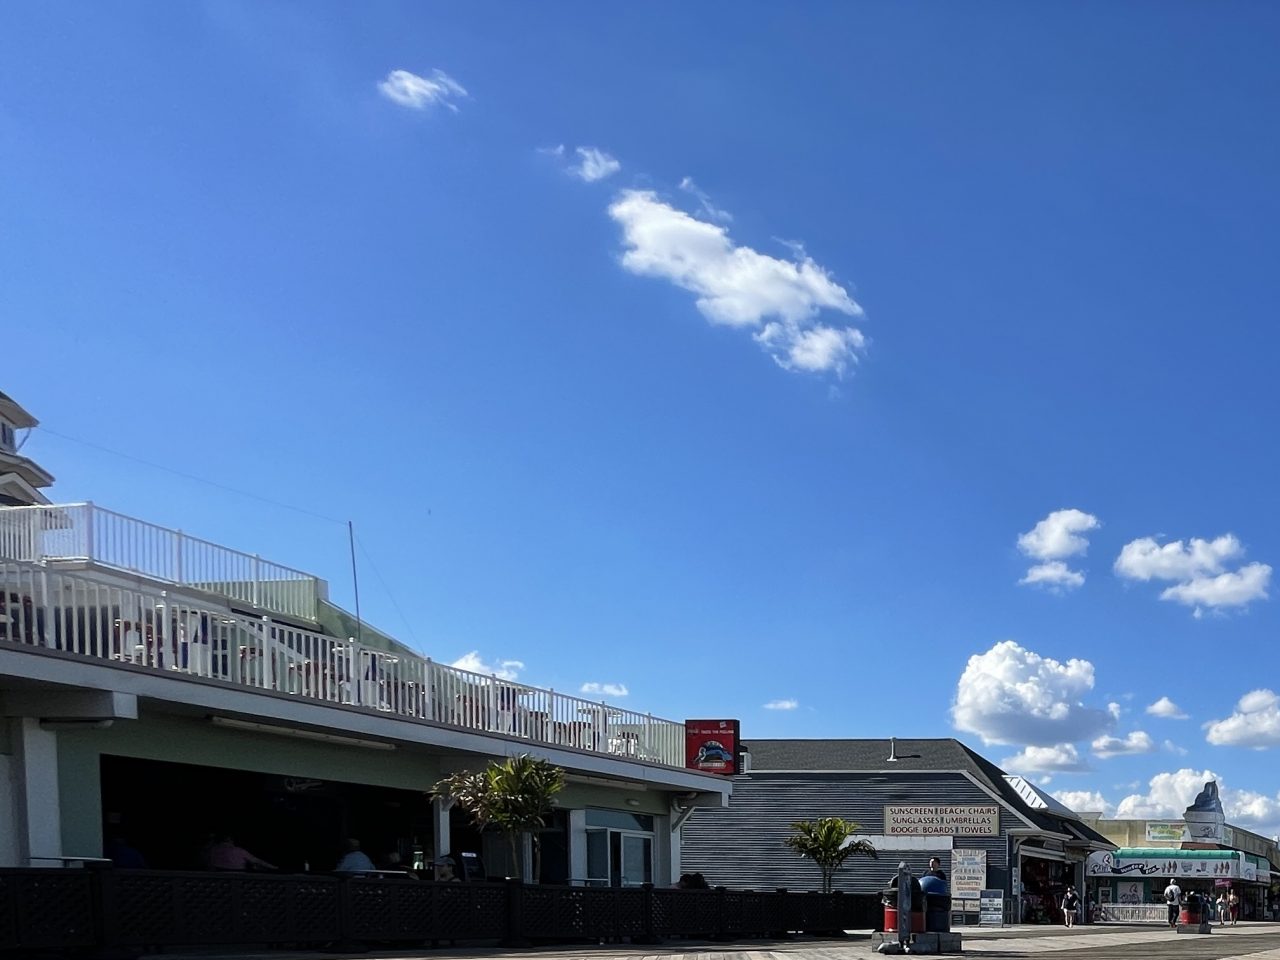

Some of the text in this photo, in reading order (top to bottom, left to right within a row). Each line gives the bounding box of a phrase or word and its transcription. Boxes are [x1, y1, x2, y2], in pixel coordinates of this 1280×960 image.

[889, 807, 997, 815] SUNSCREEN BEACH CHAIRS
[891, 826, 992, 834] BOOGIE BOARDS TOWELS
